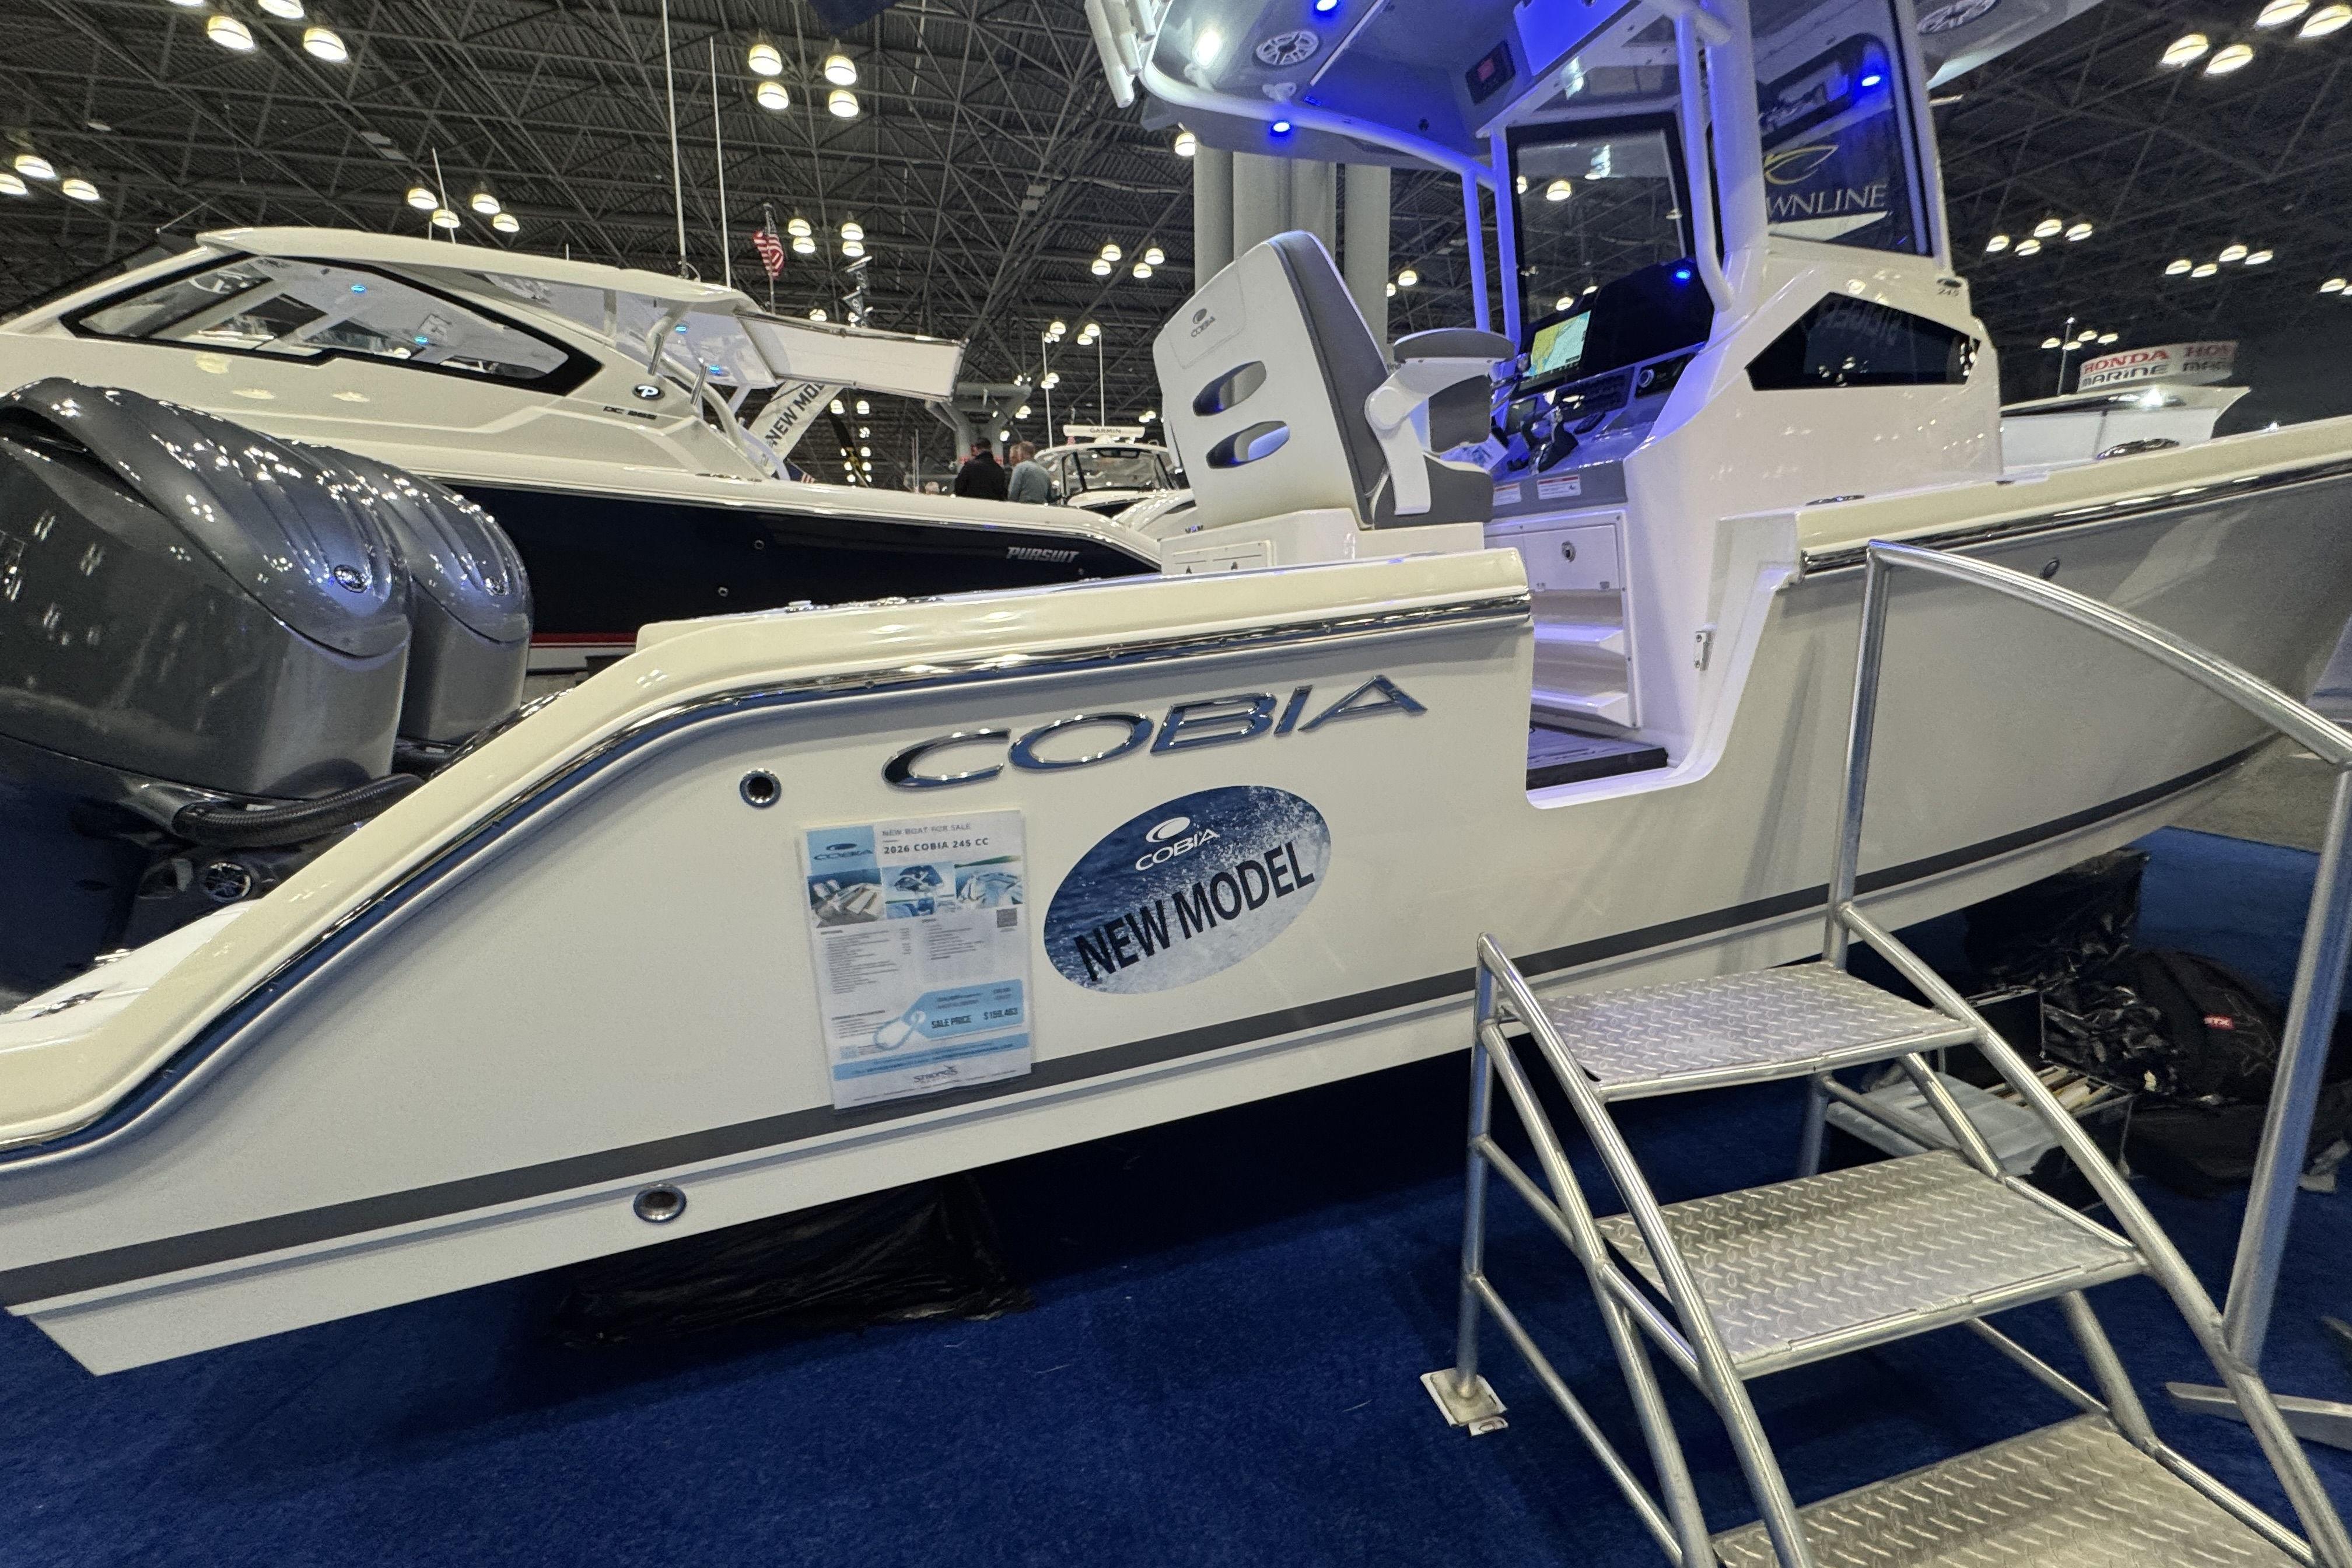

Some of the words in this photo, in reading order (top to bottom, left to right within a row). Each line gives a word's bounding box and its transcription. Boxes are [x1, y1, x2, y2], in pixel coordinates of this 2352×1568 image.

[2084, 349, 2169, 374] HONDA
[764, 406, 798, 447] NEW
[1006, 546, 1080, 563] PURSUIT
[881, 675, 1428, 789] COBIA
[951, 822, 971, 831] SALE
[814, 849, 873, 860] COBIA
[884, 845, 910, 854] 2026
[914, 841, 950, 852] COBIA
[953, 839, 971, 848] 245
[975, 838, 989, 846] CC
[1135, 828, 1220, 871] COBIA
[1073, 899, 1171, 982] NEW
[1172, 842, 1315, 940] MODEL
